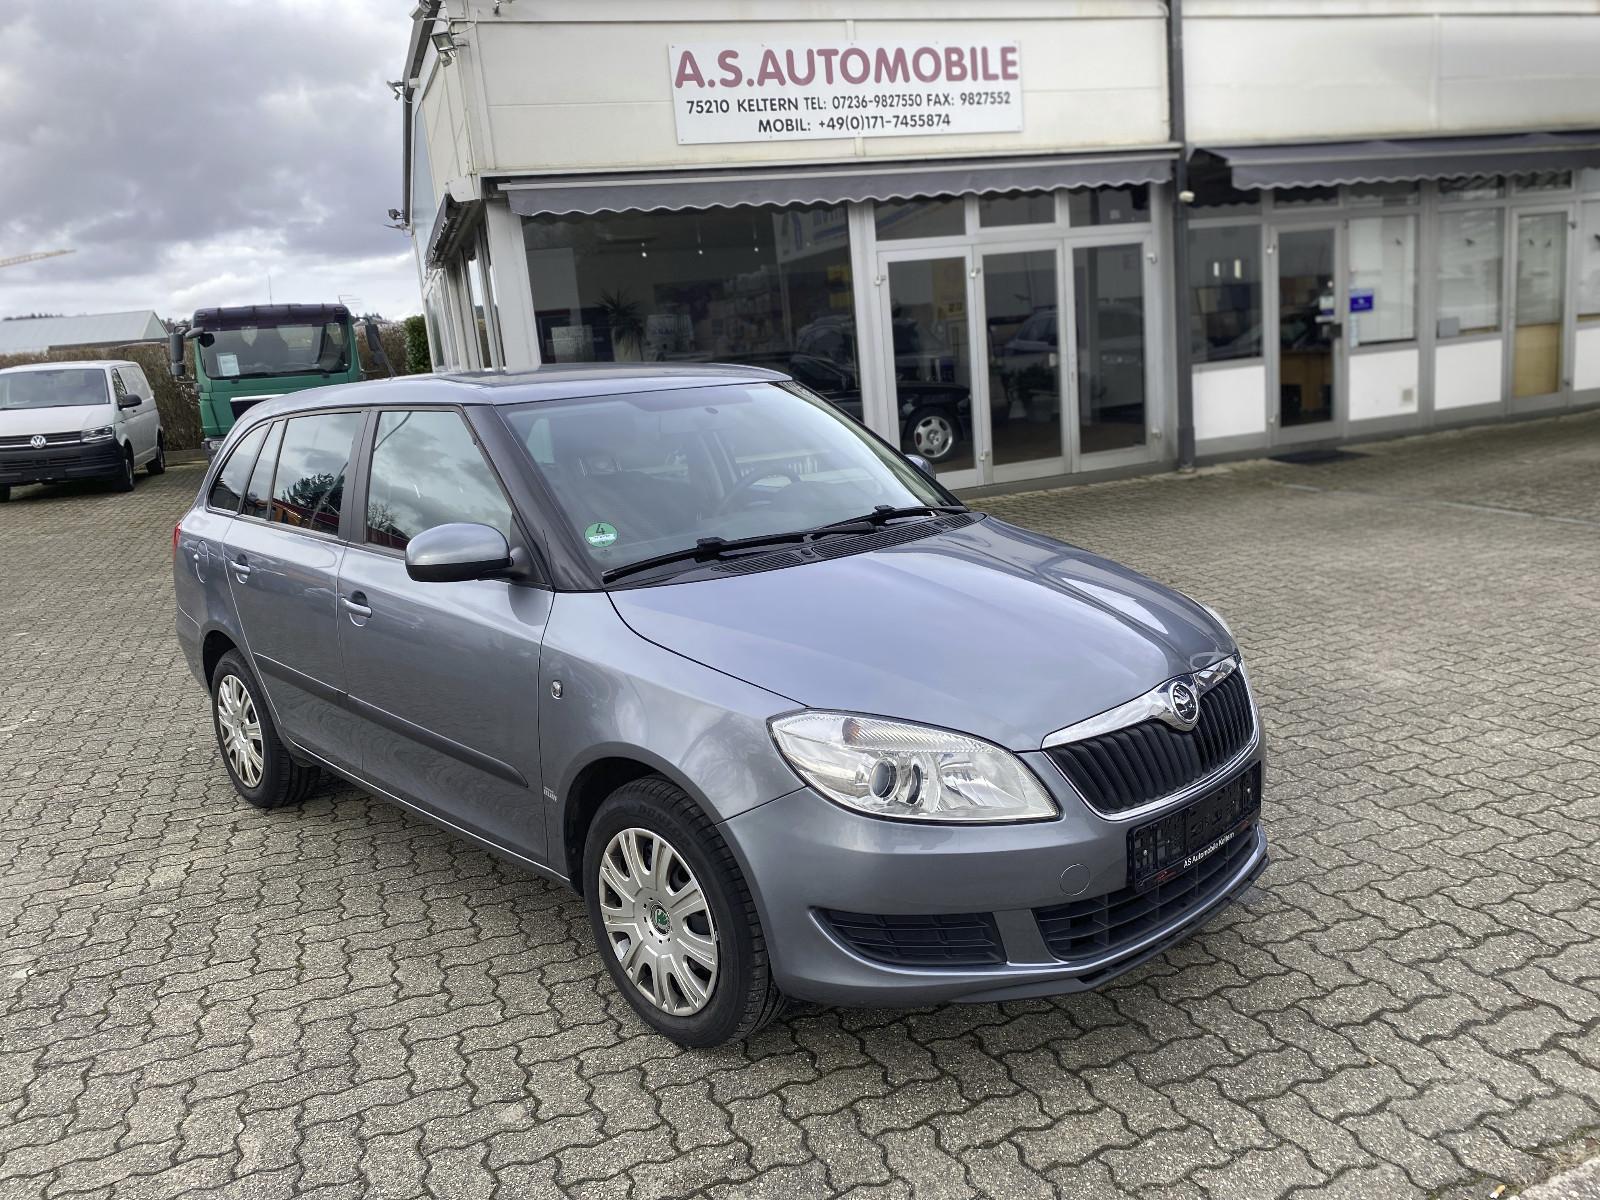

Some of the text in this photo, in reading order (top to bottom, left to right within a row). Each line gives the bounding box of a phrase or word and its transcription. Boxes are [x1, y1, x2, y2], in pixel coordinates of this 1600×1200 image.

[686, 91, 1011, 114] 75210 KELTERN TEL: 07236-9827550 FAX: 9827552
[758, 113, 951, 133] MOBIL: +49(0)171-7455874
[596, 523, 606, 535] 4
[1183, 857, 1192, 869] AS
